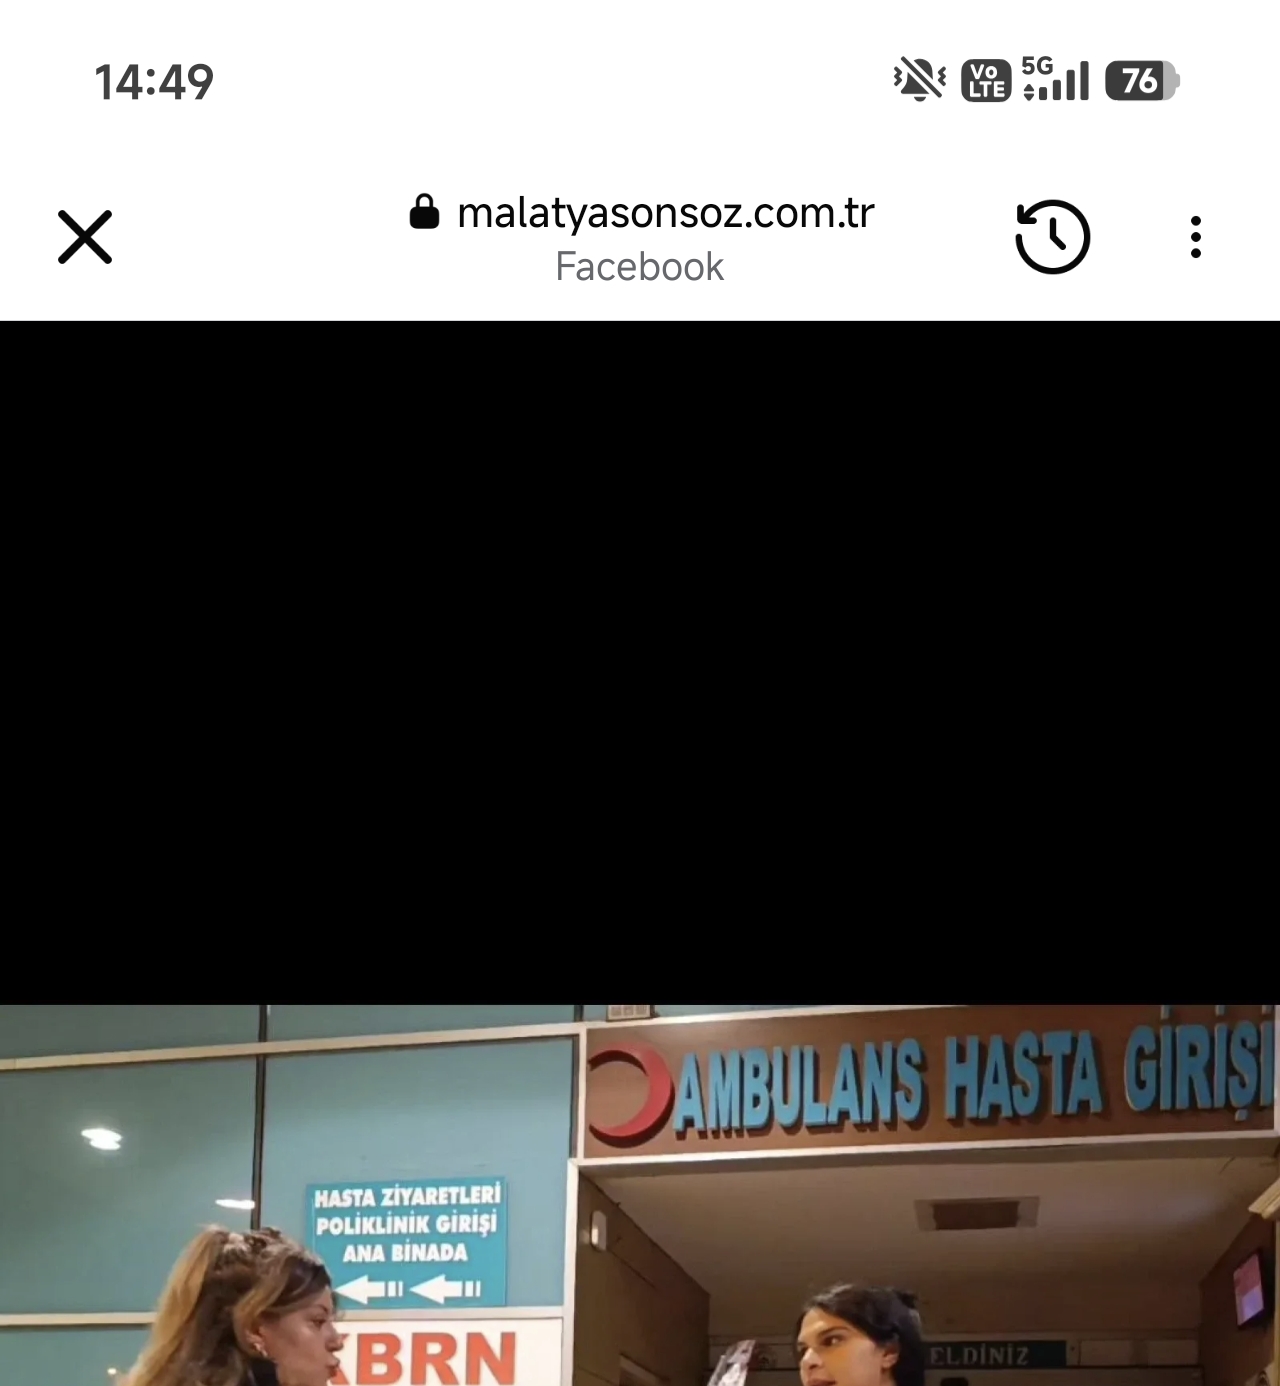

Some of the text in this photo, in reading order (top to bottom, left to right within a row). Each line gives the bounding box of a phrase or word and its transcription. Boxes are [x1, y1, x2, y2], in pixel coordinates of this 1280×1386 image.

[672, 1005, 1274, 1132] AMBULANS HASTA GİRİŞİ
[314, 1180, 502, 1209] HASTA ZİYARETLERİ
[316, 1208, 497, 1238] POLİKLİNİK GİRİŞİ
[342, 1238, 468, 1263] ANA BİNADA
[929, 1342, 1030, 1366] ELDİNİZ
